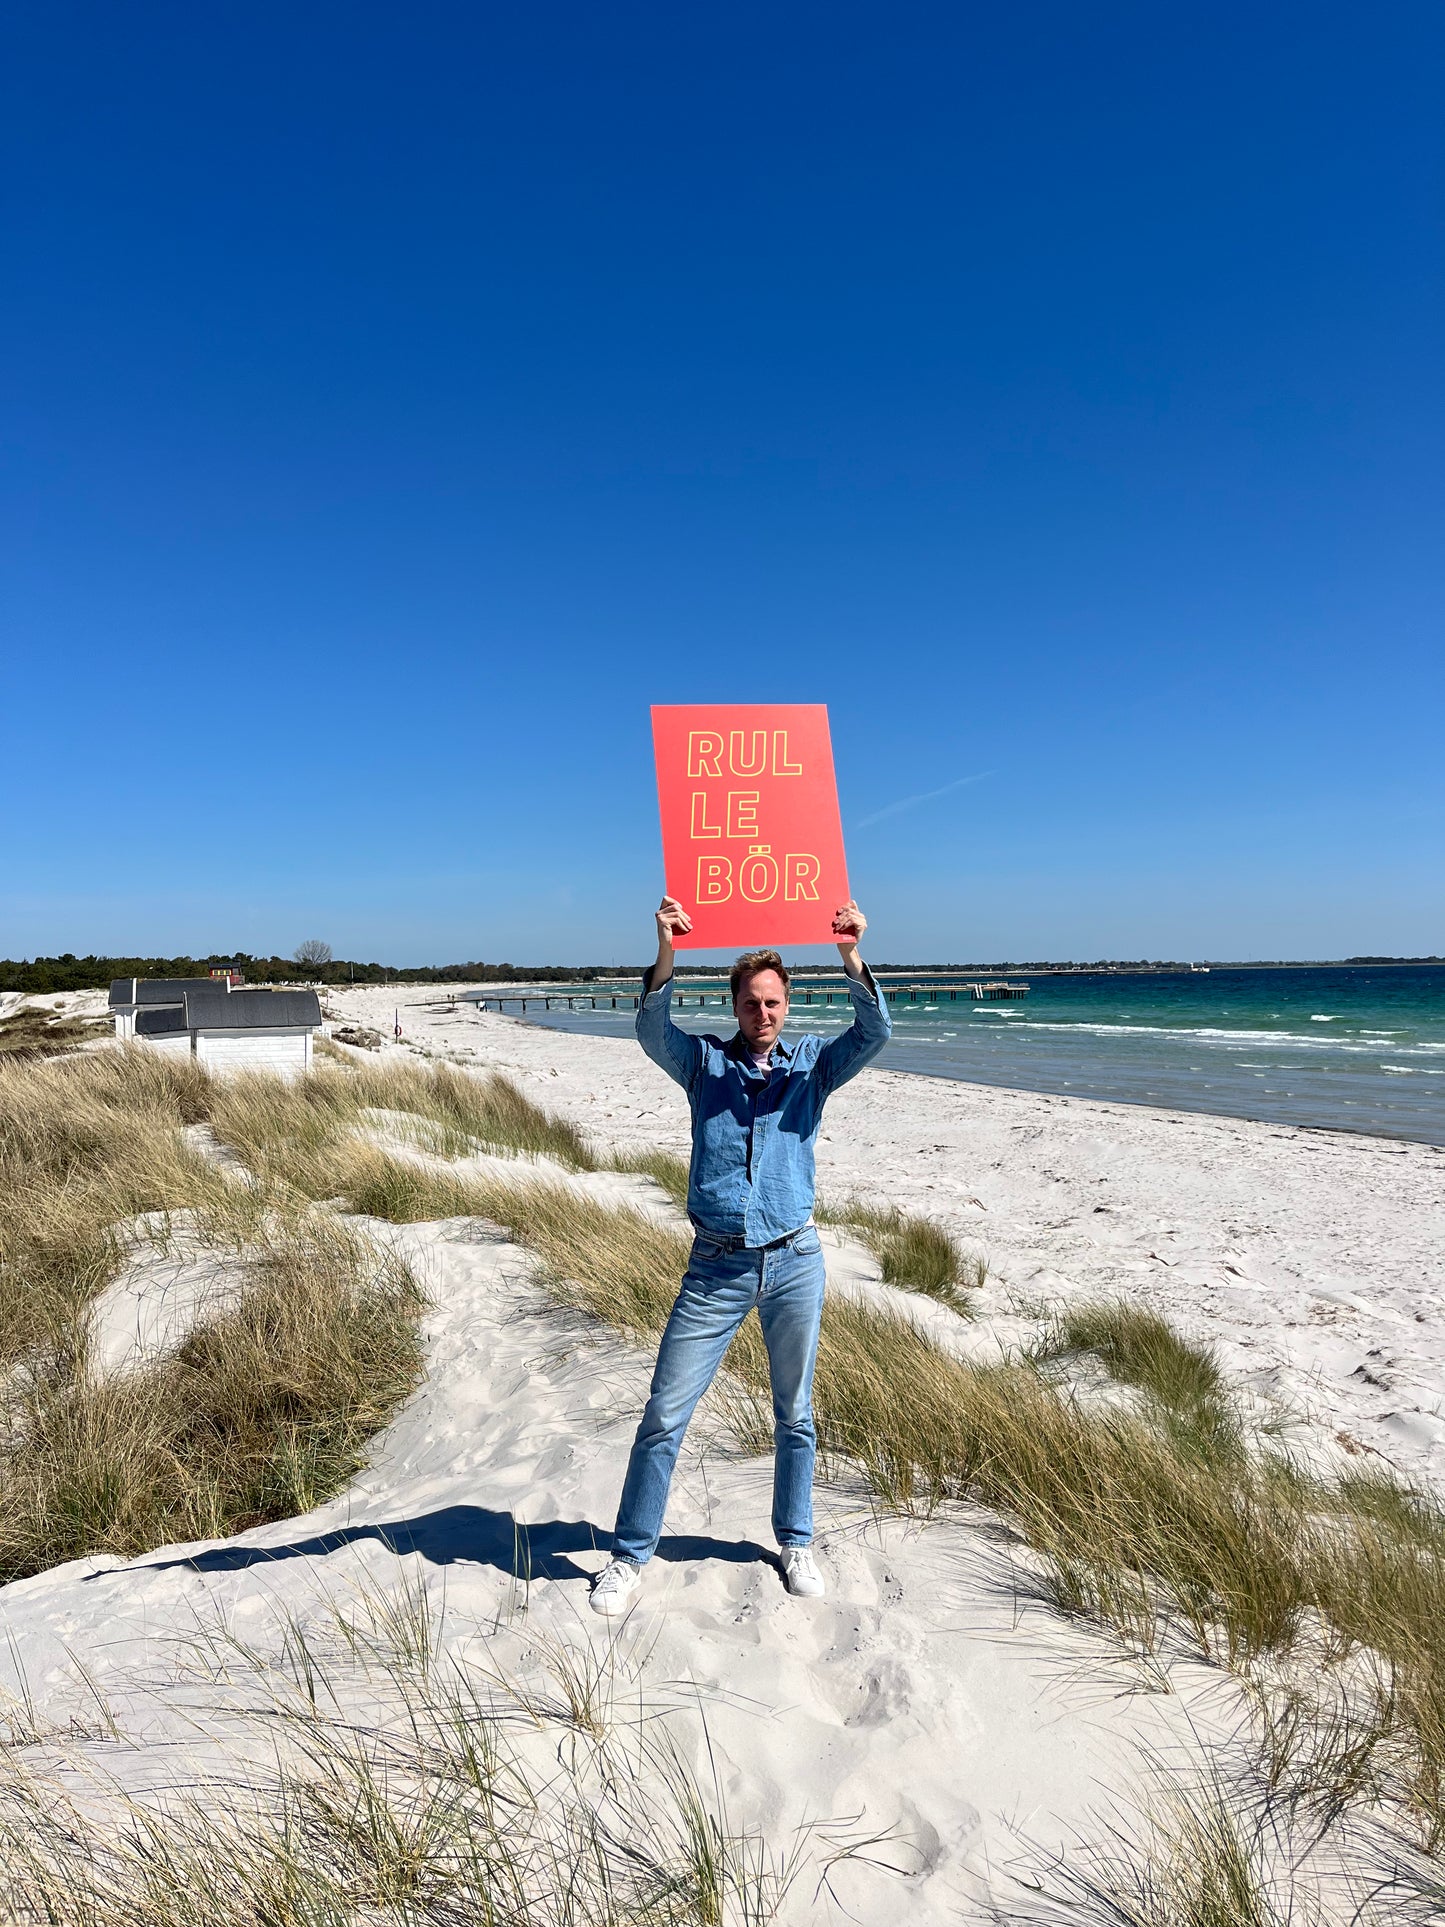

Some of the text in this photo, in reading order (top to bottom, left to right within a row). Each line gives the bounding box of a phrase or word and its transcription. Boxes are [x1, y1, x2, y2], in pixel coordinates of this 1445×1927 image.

[687, 731, 803, 777] RUL
[690, 791, 760, 839] LE
[696, 845, 820, 904] BÖR
